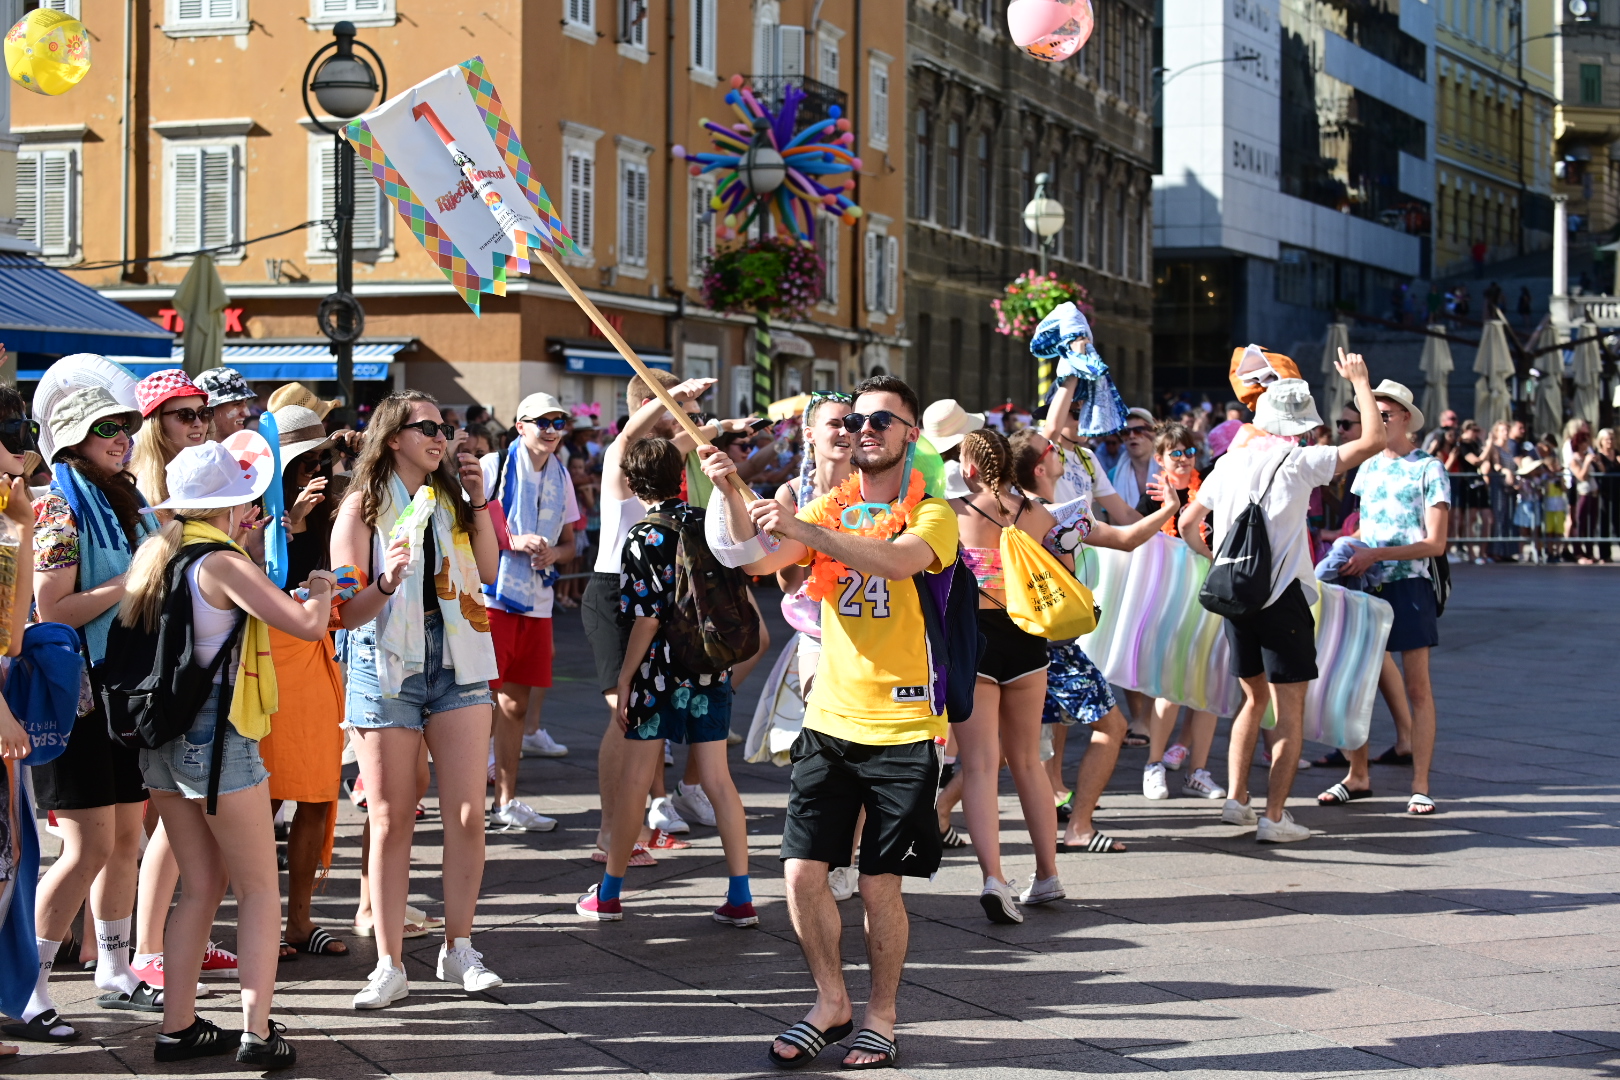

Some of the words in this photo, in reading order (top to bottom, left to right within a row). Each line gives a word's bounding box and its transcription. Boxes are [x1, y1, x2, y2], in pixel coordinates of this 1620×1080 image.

[1233, 42, 1268, 81] HOTEL
[837, 567, 890, 618] 24
[1034, 592, 1066, 611] HONEY
[99, 933, 120, 942] Los
[99, 940, 129, 952] ngeles
